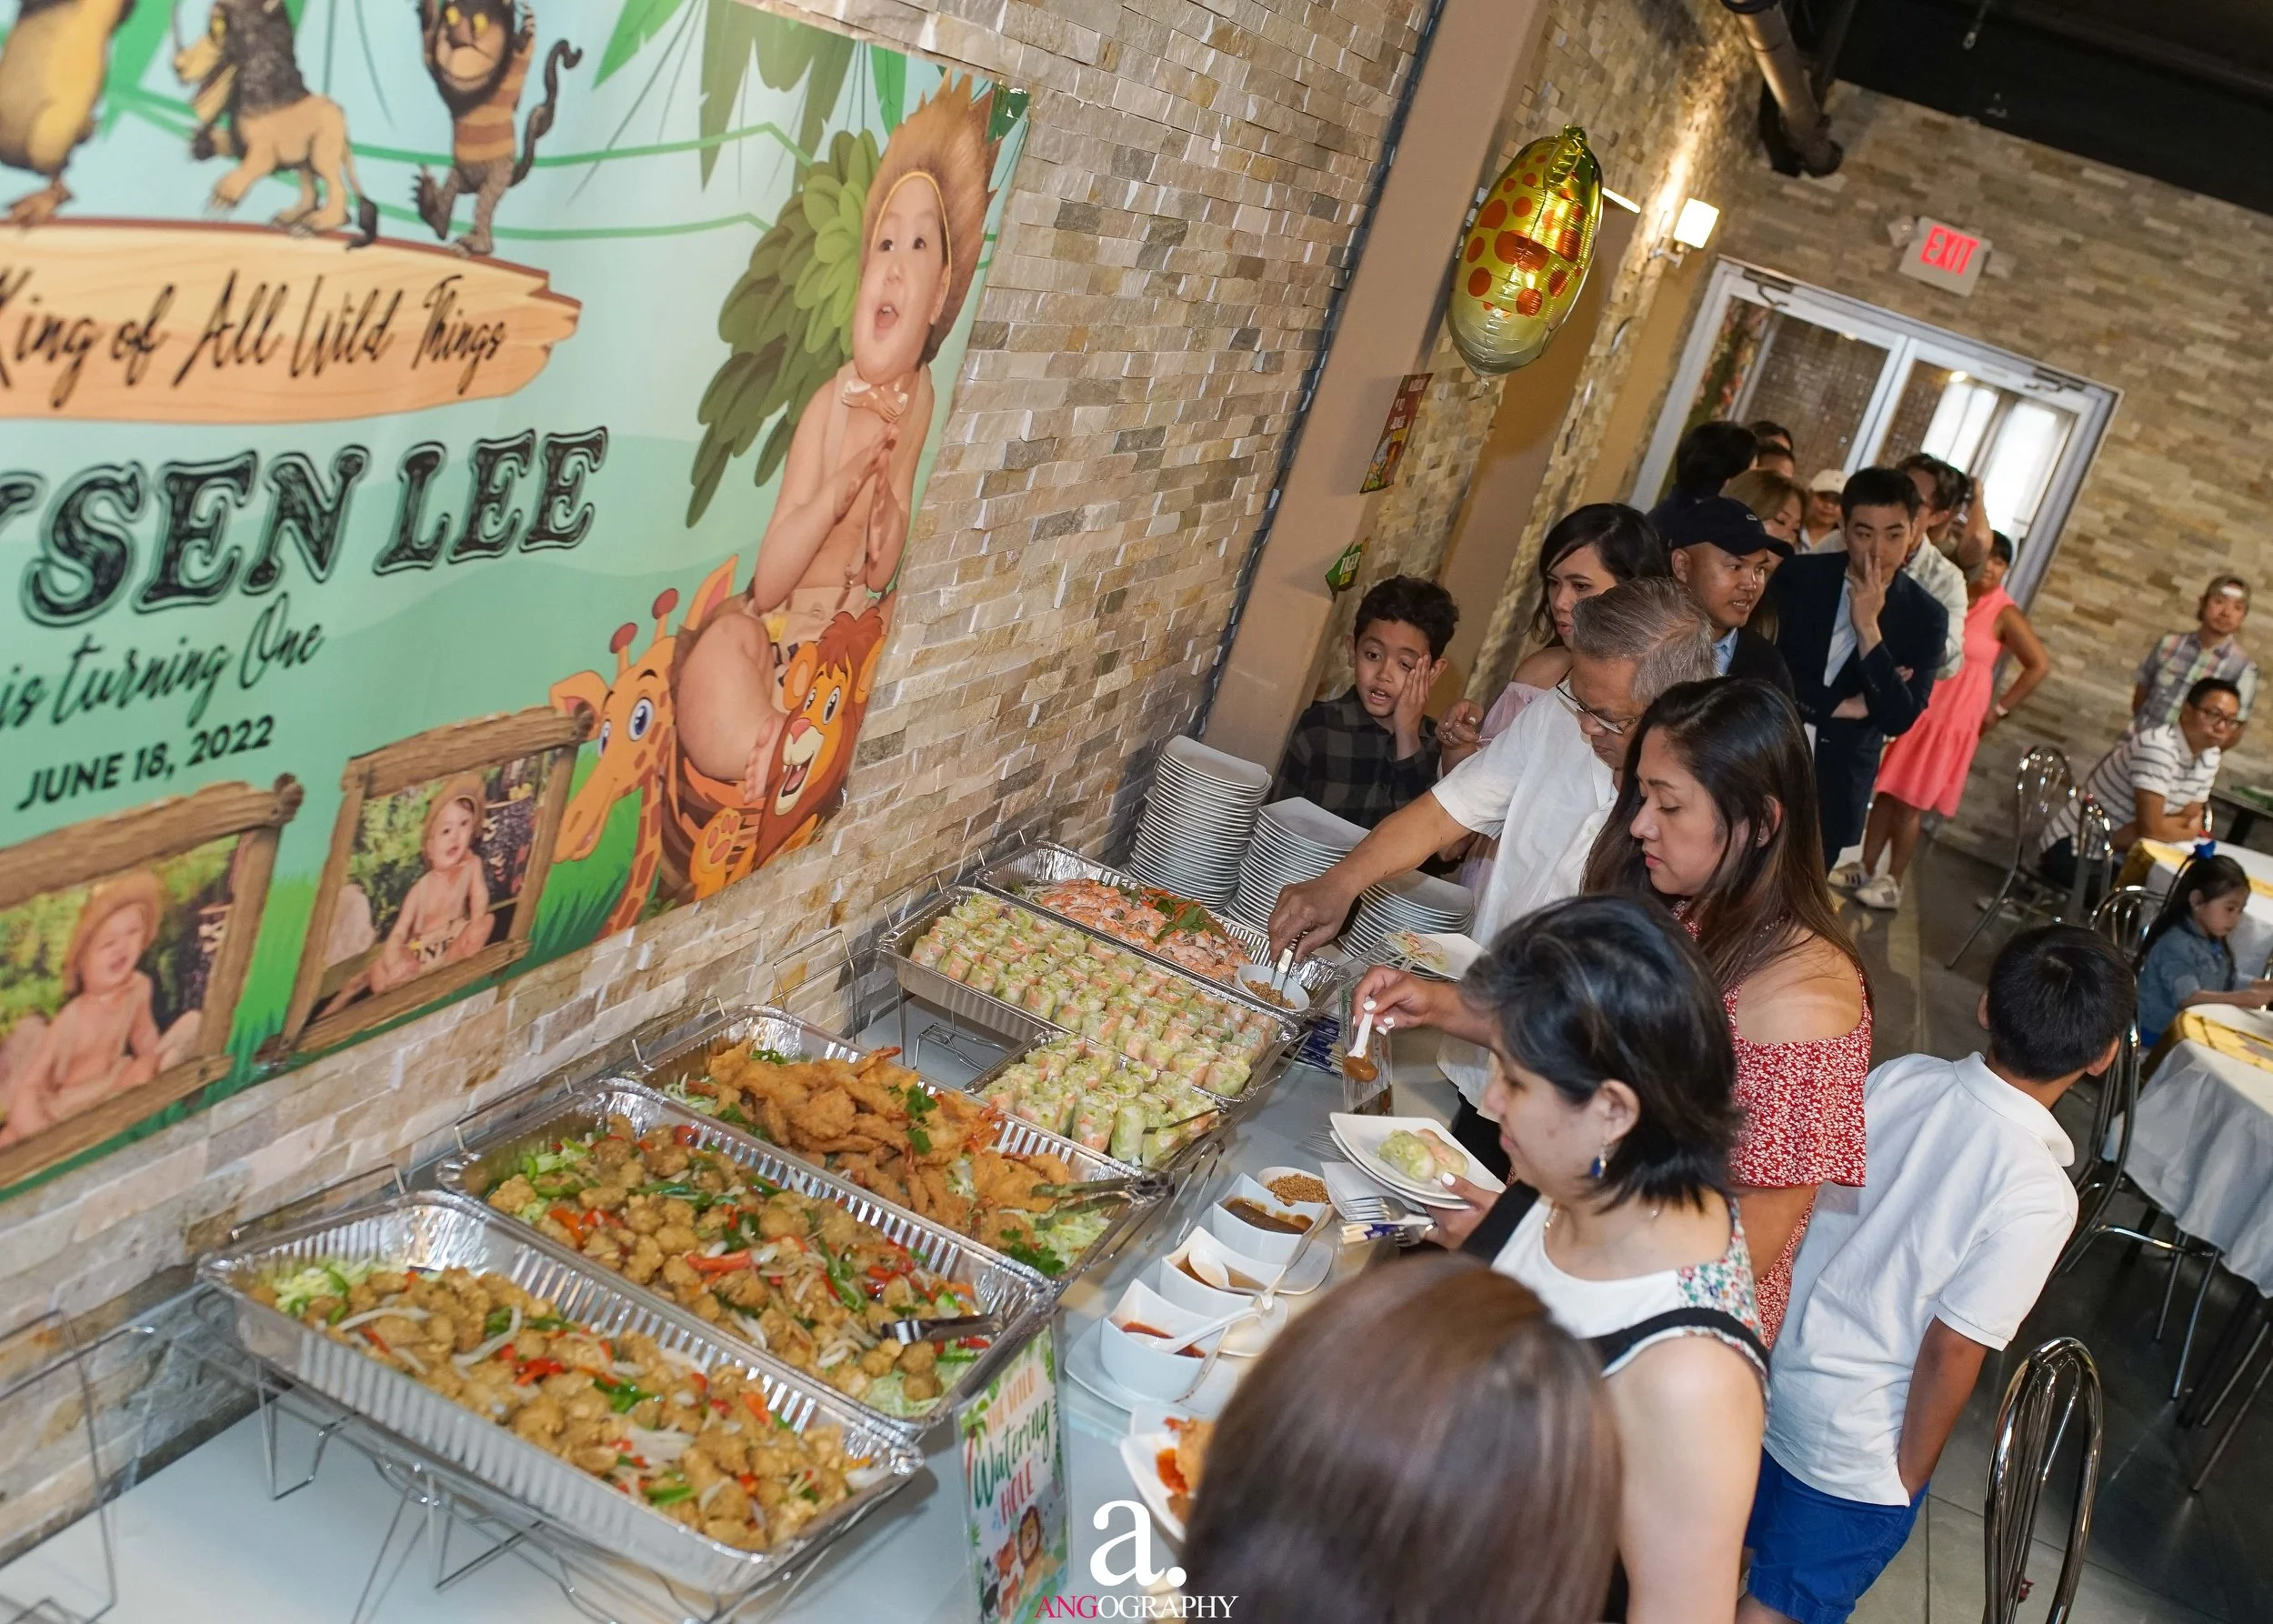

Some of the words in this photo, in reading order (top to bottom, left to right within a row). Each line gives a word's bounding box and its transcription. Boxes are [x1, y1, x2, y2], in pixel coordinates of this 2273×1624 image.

[1919, 224, 1980, 276] EXIT
[109, 283, 171, 387] of
[170, 267, 285, 388] All
[288, 273, 404, 378] Wild
[411, 274, 506, 396] Things
[373, 426, 608, 576] LEE
[0, 664, 47, 728] is
[51, 633, 234, 728] turning
[238, 589, 325, 690] One
[15, 752, 125, 812] JUNE
[132, 741, 175, 781] 18,
[185, 715, 275, 767] 2022
[973, 1400, 1050, 1510] Watering
